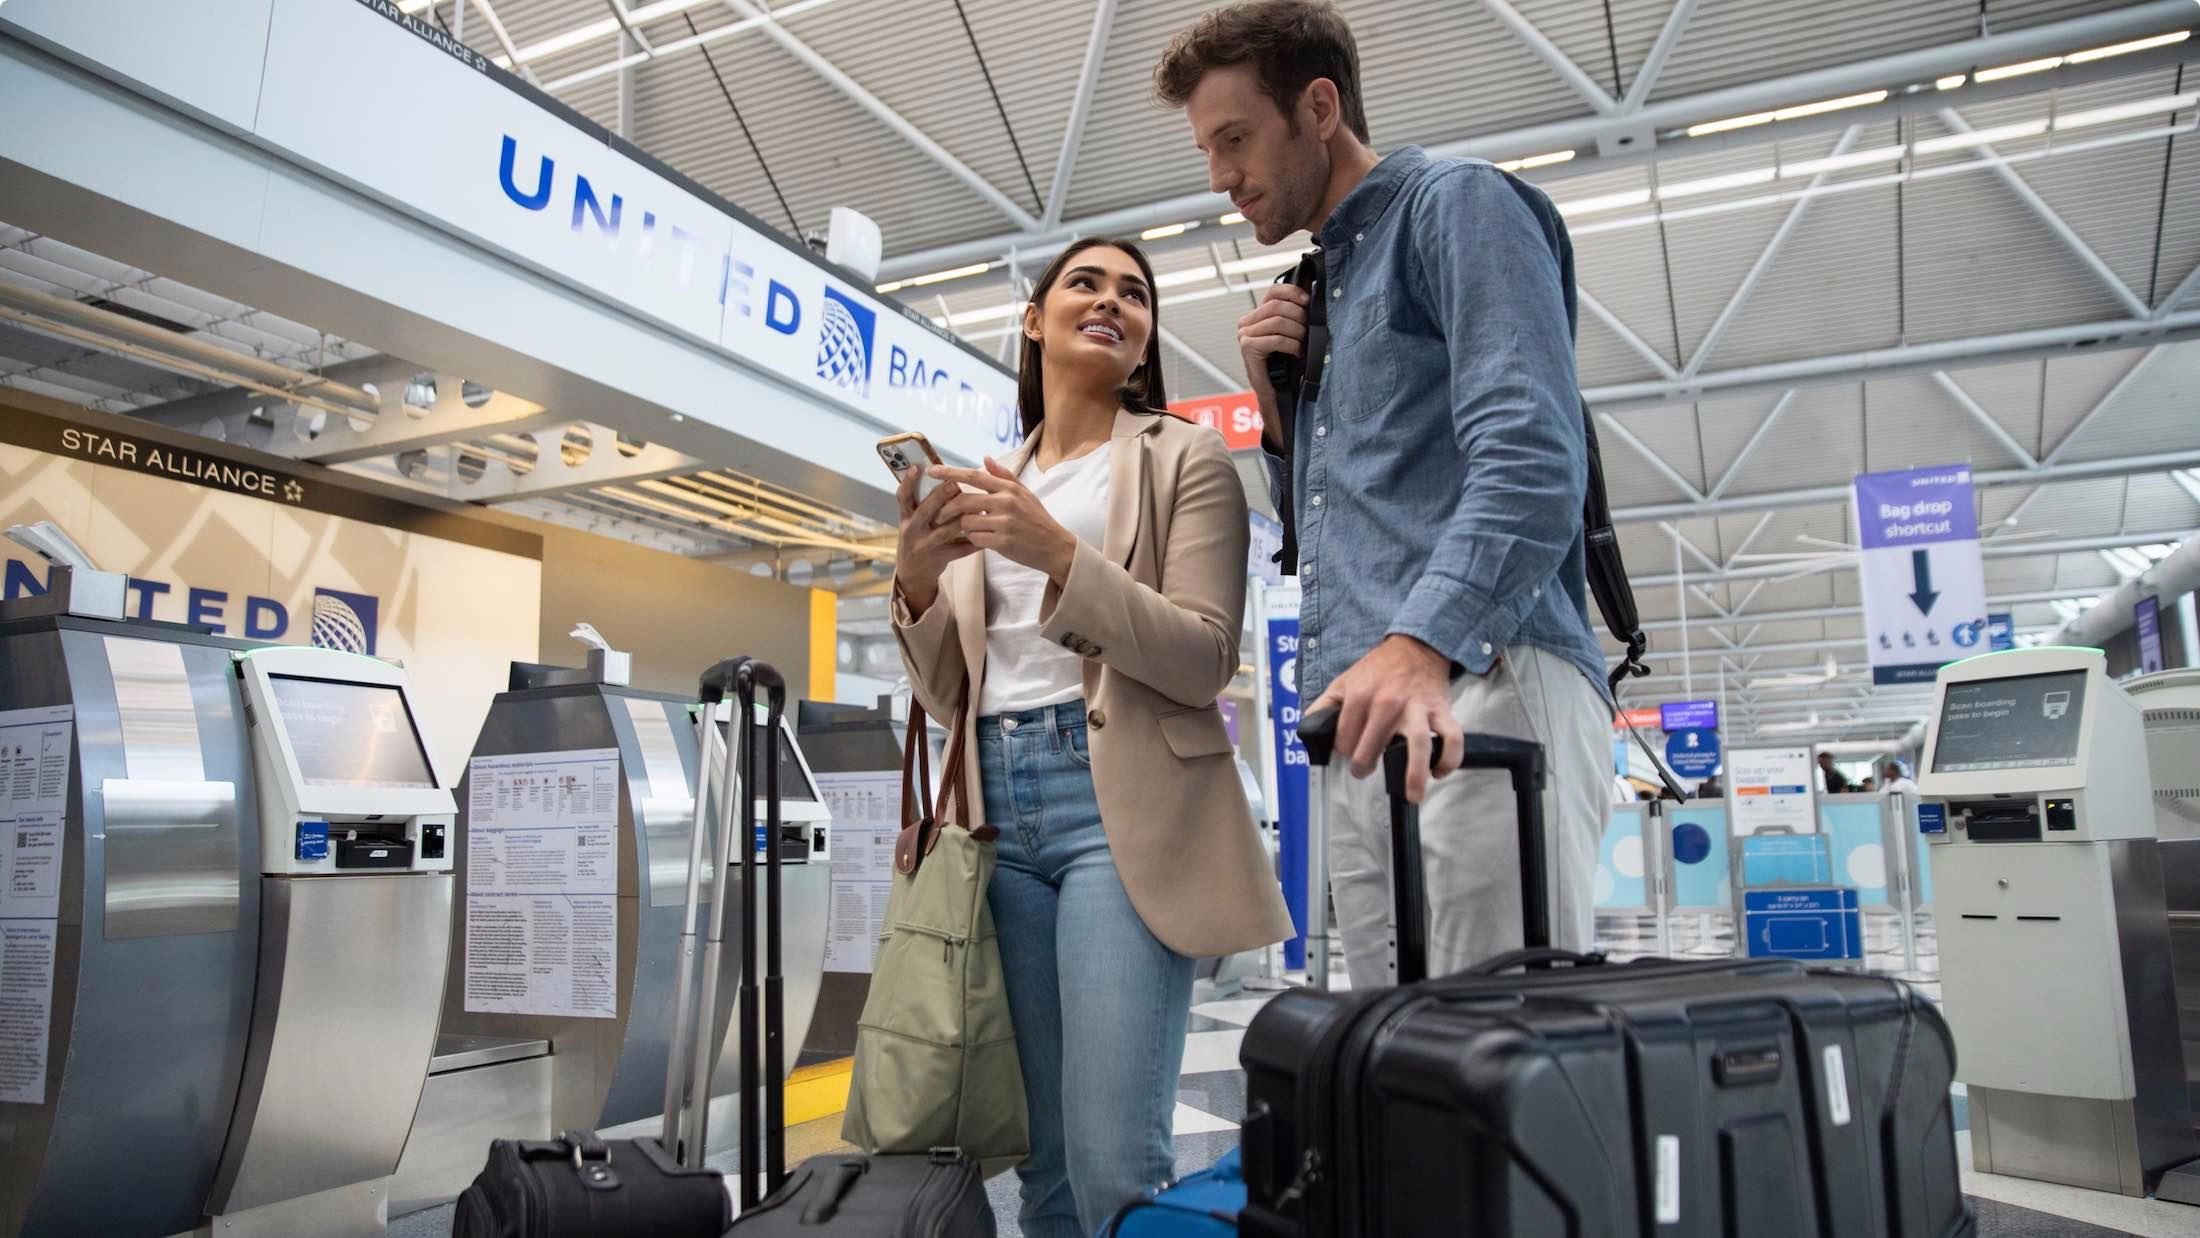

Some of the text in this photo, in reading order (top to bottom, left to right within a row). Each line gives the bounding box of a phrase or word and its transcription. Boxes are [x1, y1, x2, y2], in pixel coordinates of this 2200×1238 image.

[402, 15, 473, 63] ALLIANCE
[499, 133, 801, 336] UNITED
[888, 344, 949, 414] BAG
[61, 428, 276, 495] STAR ALLIANCE
[1880, 500, 1953, 520] Bag drop
[1885, 520, 1952, 539] shortcut
[3, 558, 290, 640] NTED
[1951, 699, 2017, 711] Scan boarding
[1983, 710, 2010, 719] begin
